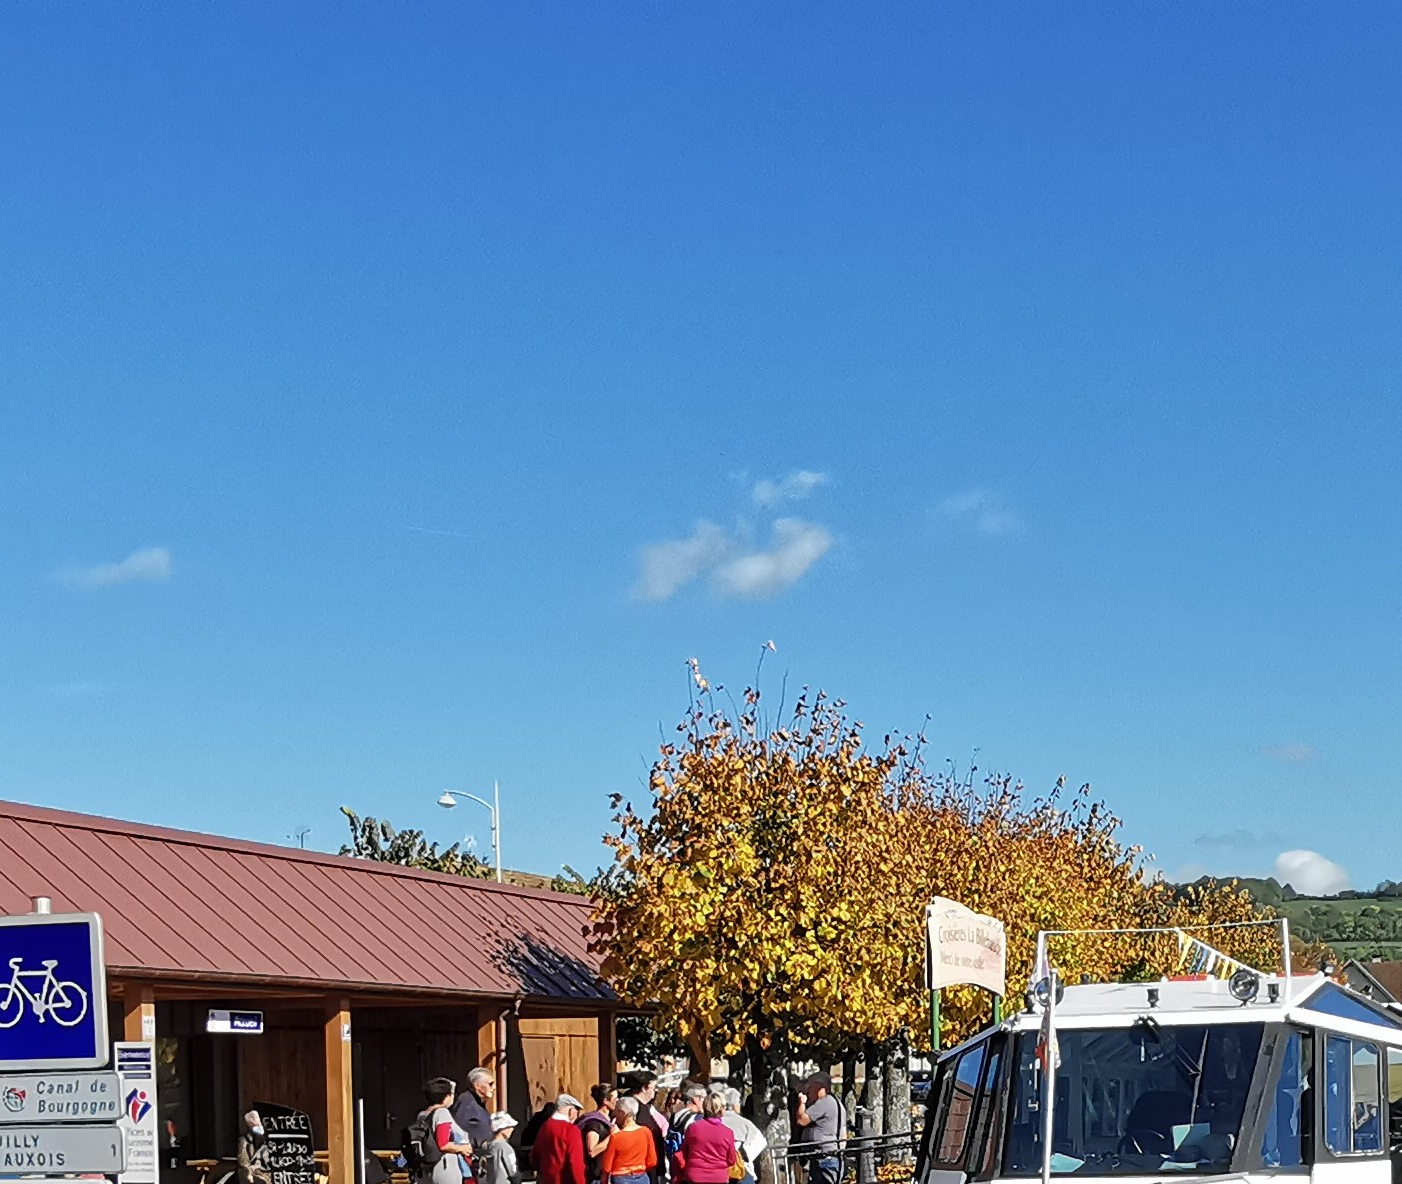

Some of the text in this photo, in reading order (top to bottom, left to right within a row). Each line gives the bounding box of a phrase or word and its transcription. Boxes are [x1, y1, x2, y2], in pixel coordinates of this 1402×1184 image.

[36, 1079, 107, 1095] Canal de
[38, 1099, 115, 1116] Bourgogne
[111, 1143, 117, 1158] 1
[4, 1152, 65, 1167] AUXOIS
